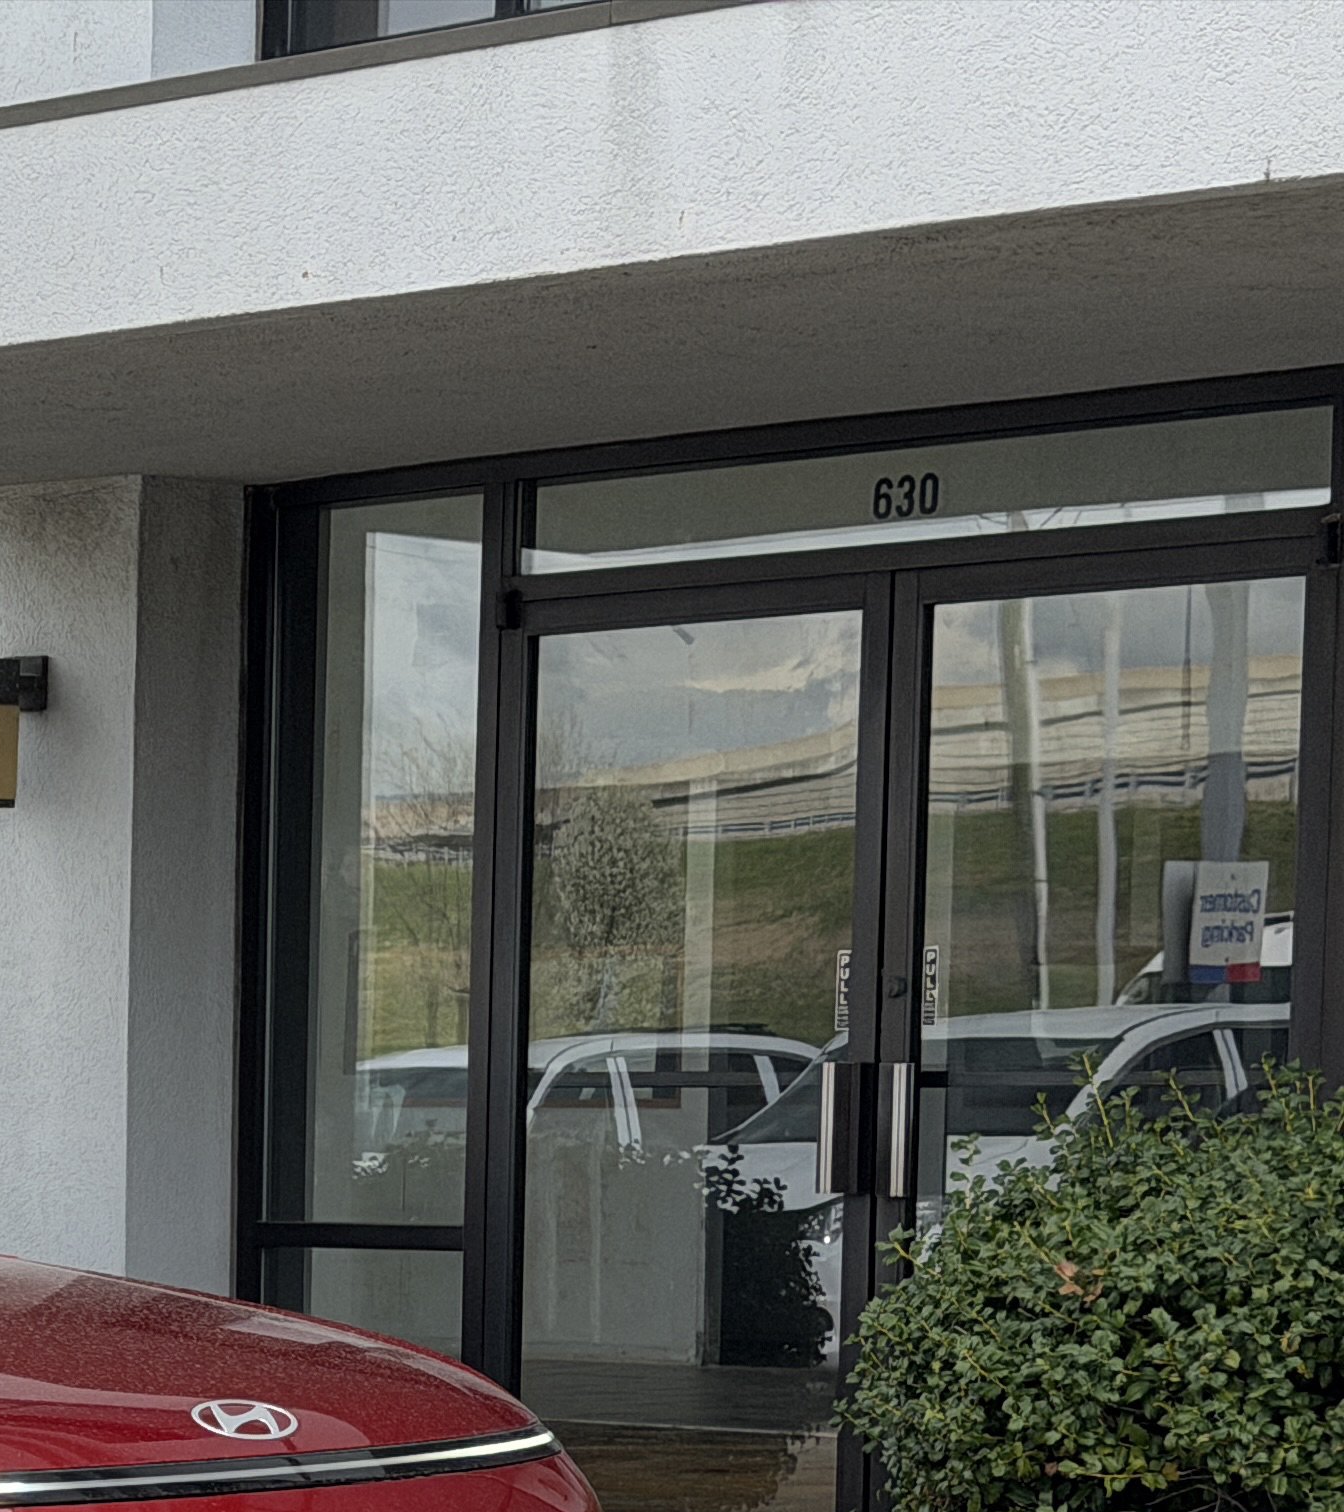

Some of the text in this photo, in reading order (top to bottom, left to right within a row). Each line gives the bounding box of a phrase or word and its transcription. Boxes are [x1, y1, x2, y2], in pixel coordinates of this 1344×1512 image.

[872, 472, 939, 519] 630
[839, 955, 850, 1005] PULL
[925, 951, 936, 1001] PULL
